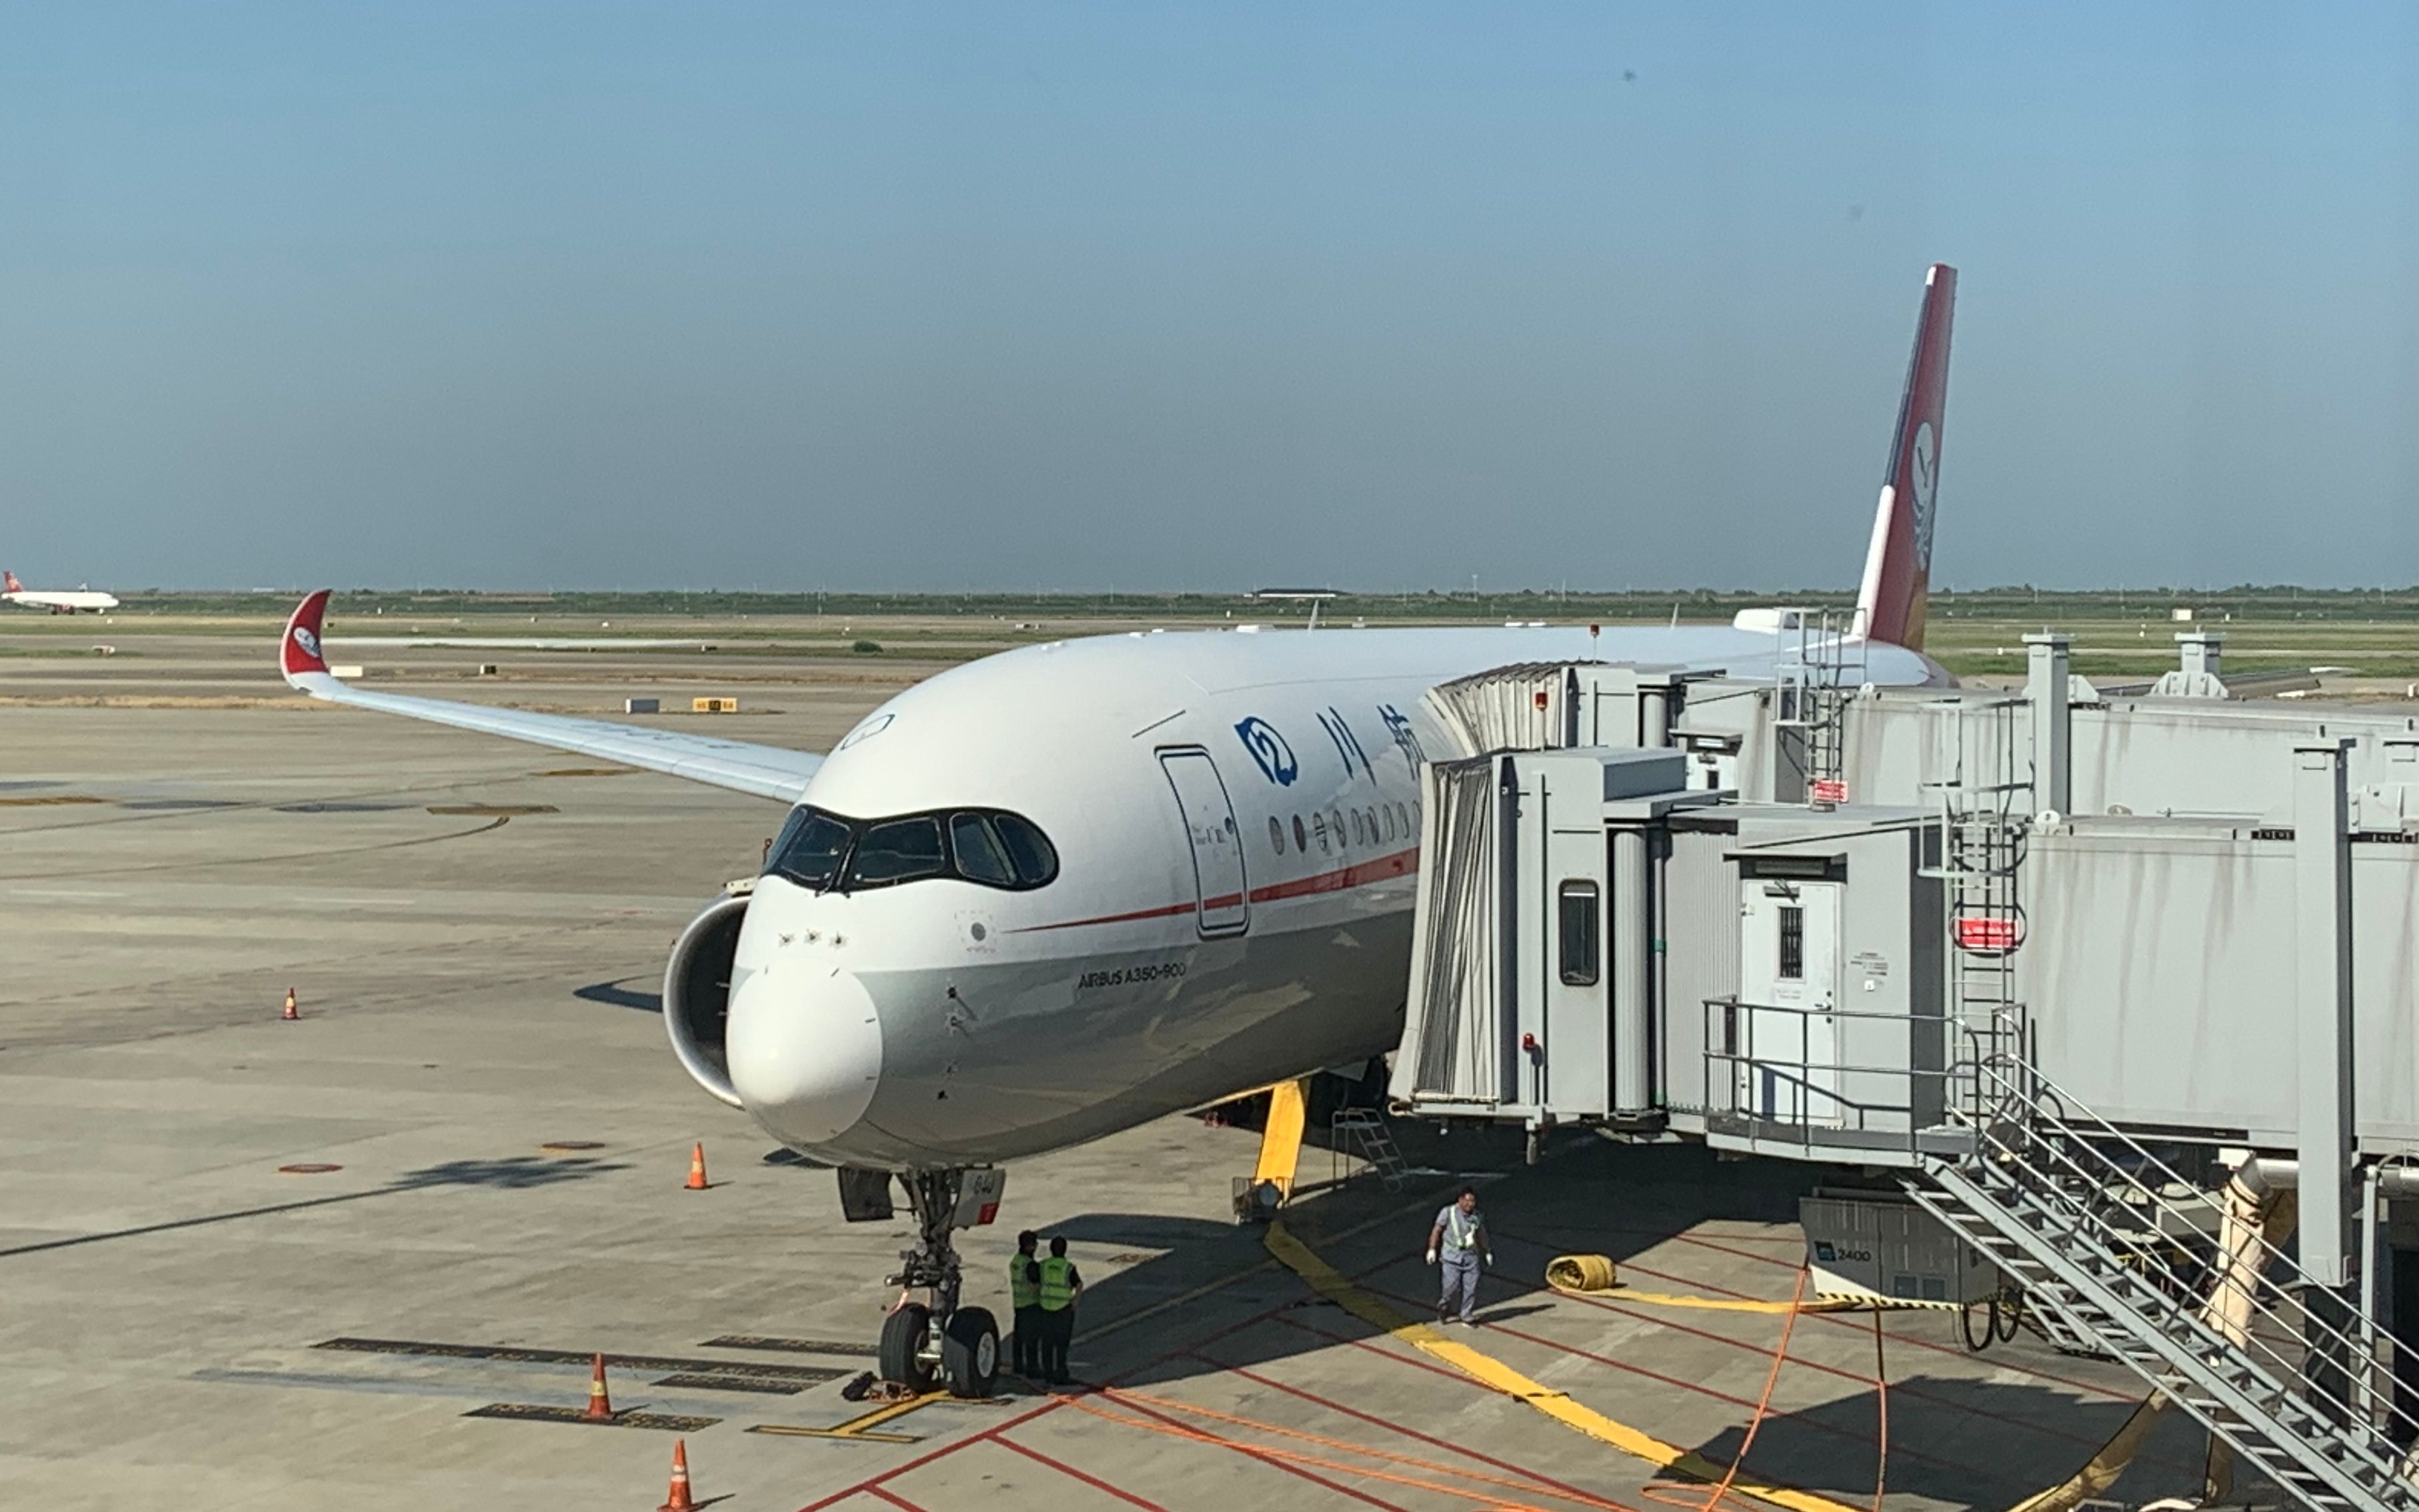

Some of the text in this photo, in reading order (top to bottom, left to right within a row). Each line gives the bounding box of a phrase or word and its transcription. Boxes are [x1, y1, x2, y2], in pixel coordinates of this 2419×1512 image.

[1077, 962, 1186, 989] AIRBUS A350-900
[1838, 1249, 1872, 1261] 2400
